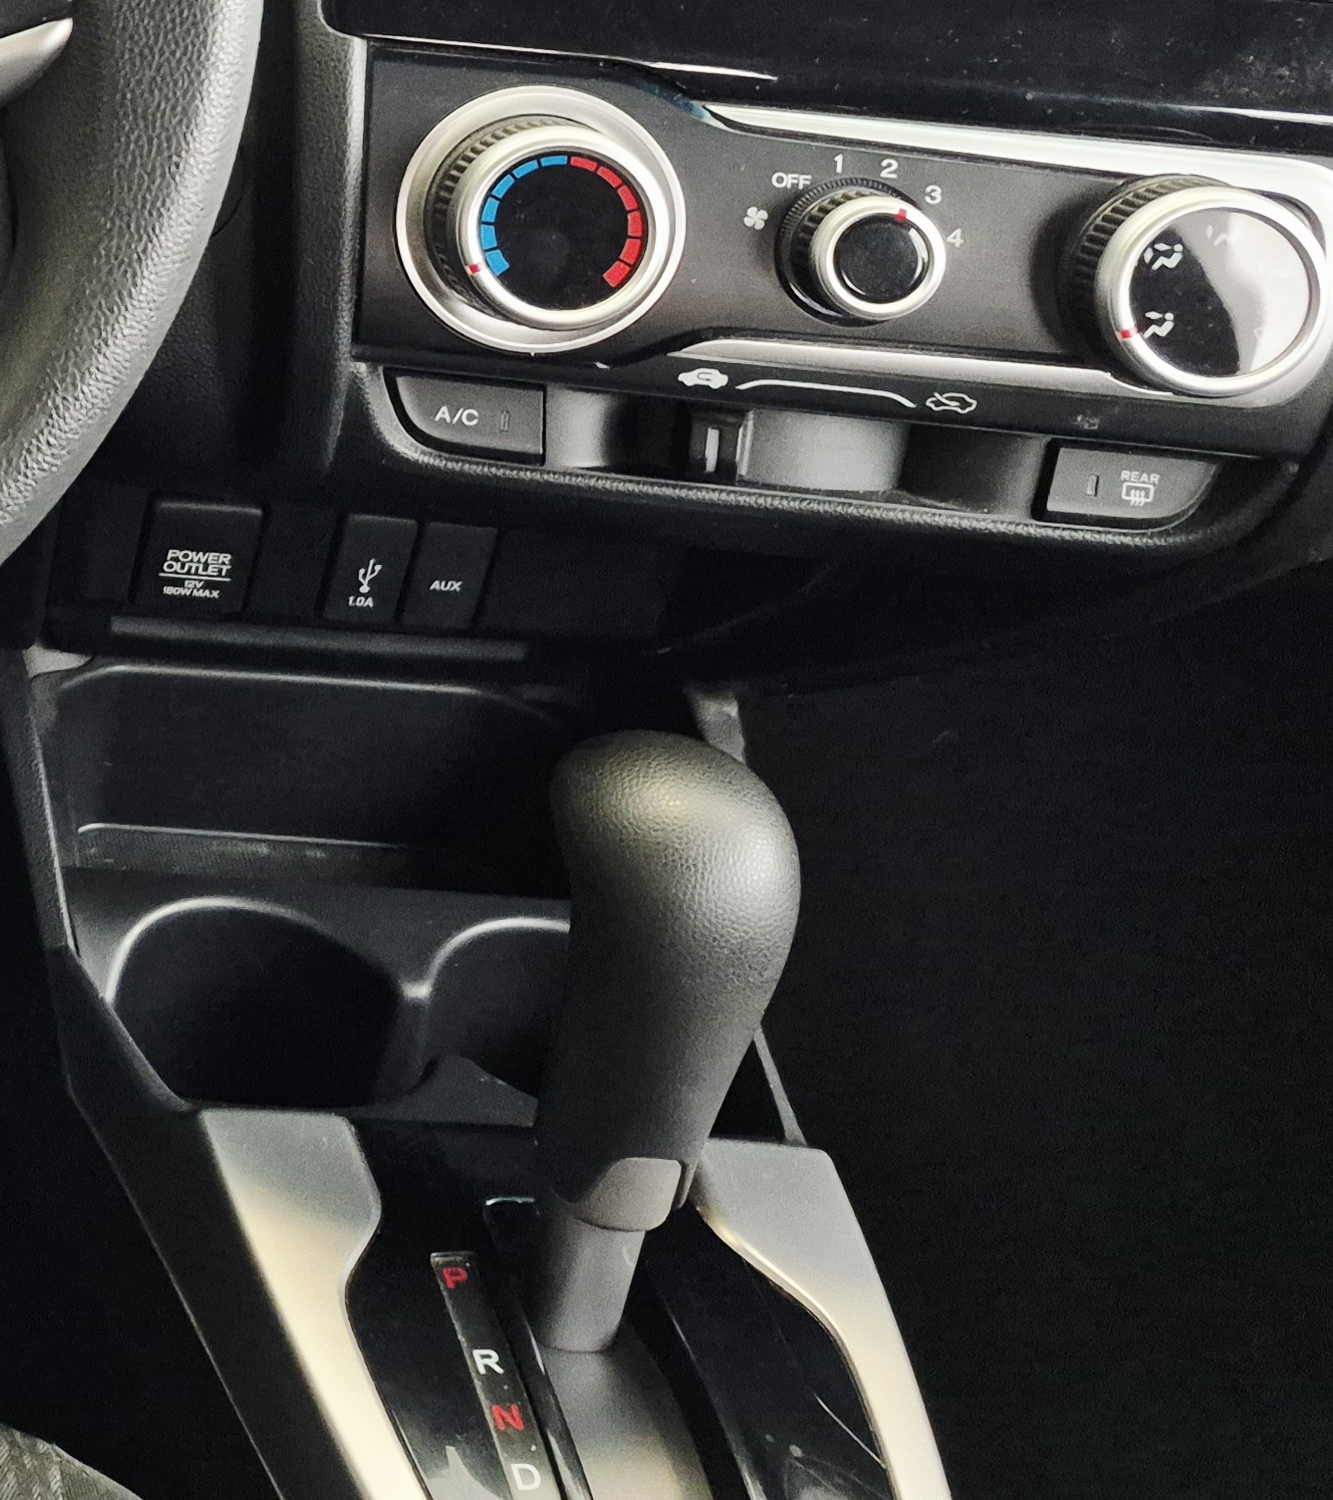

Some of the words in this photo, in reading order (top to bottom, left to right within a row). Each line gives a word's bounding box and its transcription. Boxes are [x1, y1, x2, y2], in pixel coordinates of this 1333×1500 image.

[833, 155, 843, 173] 1
[881, 160, 898, 178] 2
[772, 172, 811, 189] OFF
[925, 185, 942, 203] 3
[947, 232, 964, 248] 4
[434, 405, 479, 426] A/C
[1121, 470, 1160, 485] REAR
[167, 549, 232, 564] POWER
[163, 562, 231, 577] OUTLET
[183, 580, 204, 588] 12V
[429, 580, 463, 592] AUX
[193, 588, 220, 599] MAX
[348, 595, 374, 608] 1.0A
[442, 1267, 468, 1290] P
[472, 1348, 504, 1375] R
[490, 1404, 524, 1431] N
[511, 1463, 542, 1491] D
